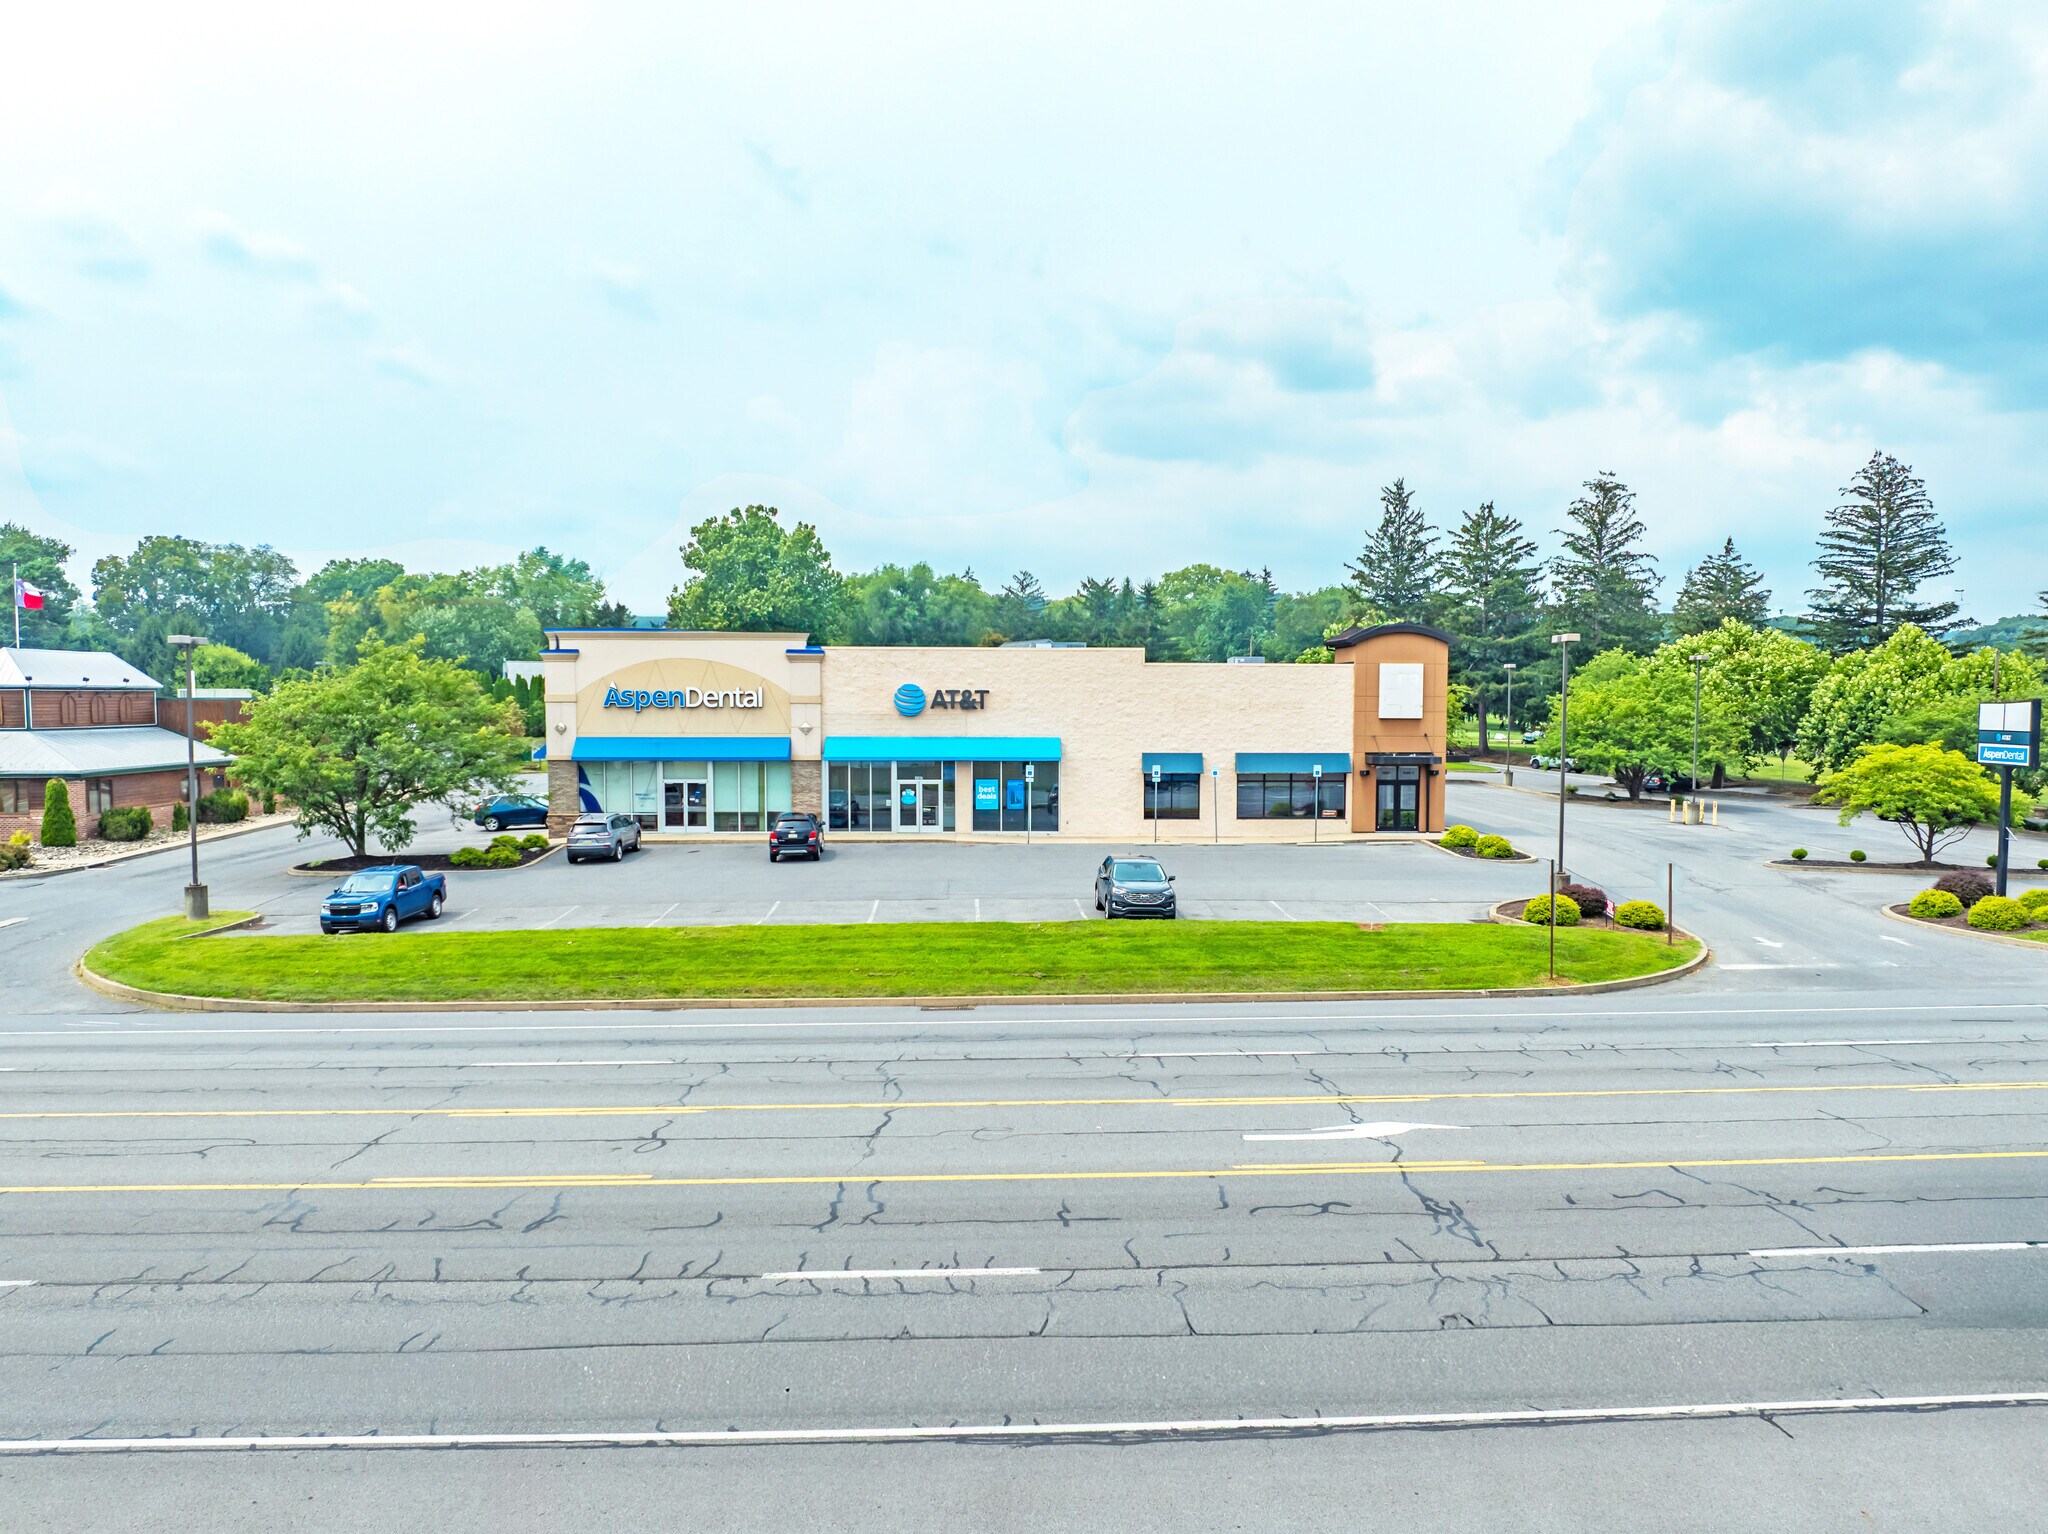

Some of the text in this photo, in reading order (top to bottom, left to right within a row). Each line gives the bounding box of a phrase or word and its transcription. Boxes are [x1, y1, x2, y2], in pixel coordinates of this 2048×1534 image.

[603, 681, 763, 712] AspenDental
[930, 689, 990, 710] AT&T
[977, 792, 997, 800] deals
[978, 785, 996, 793] best
